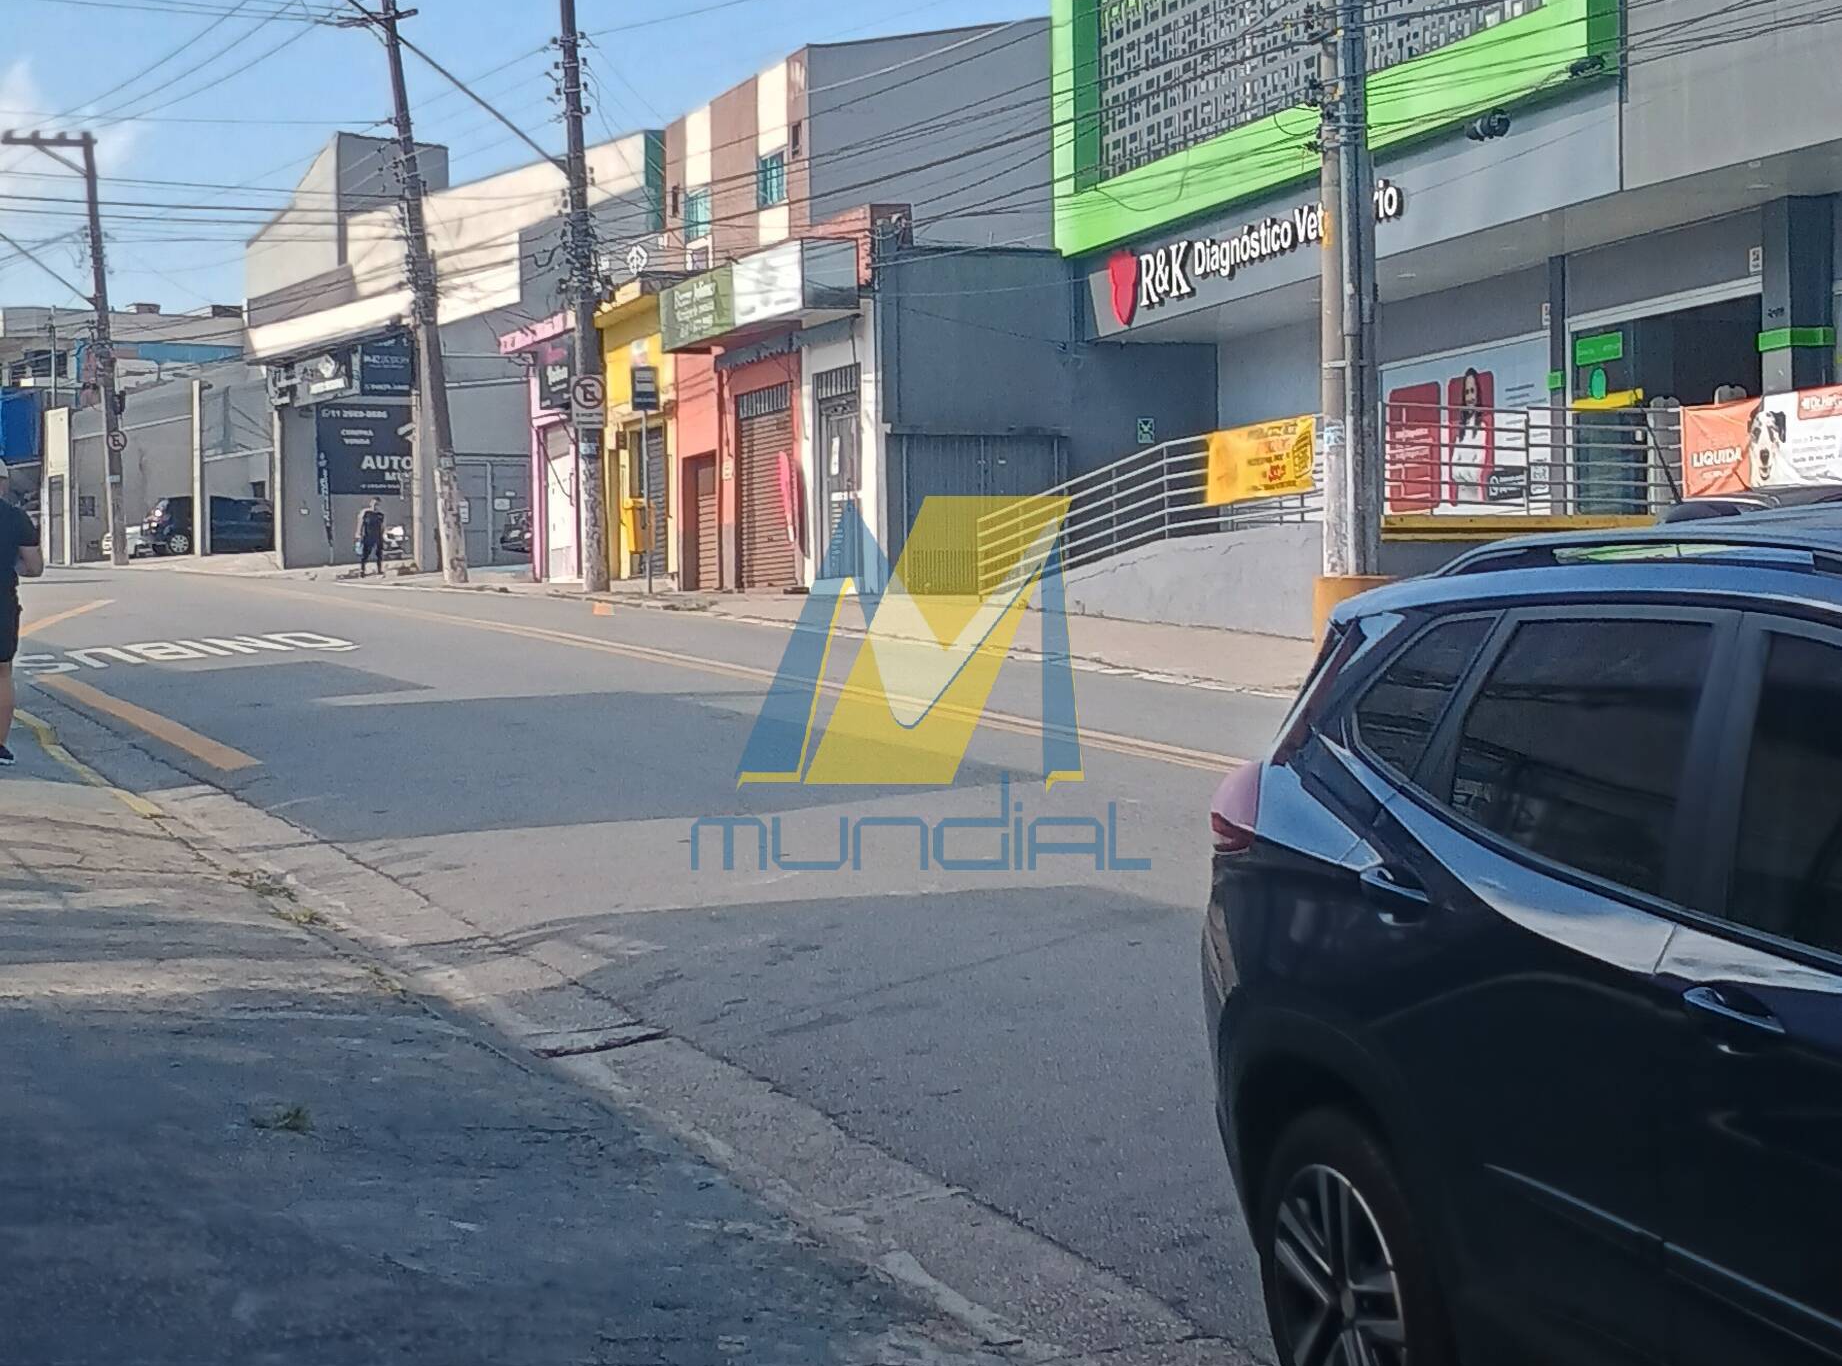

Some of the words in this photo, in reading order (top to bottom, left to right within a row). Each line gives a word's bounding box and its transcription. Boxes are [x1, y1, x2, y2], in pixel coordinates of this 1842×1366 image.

[1140, 241, 1191, 306] R&K
[1194, 218, 1291, 276] Diagnóstico
[1692, 446, 1743, 468] LIQUIDA
